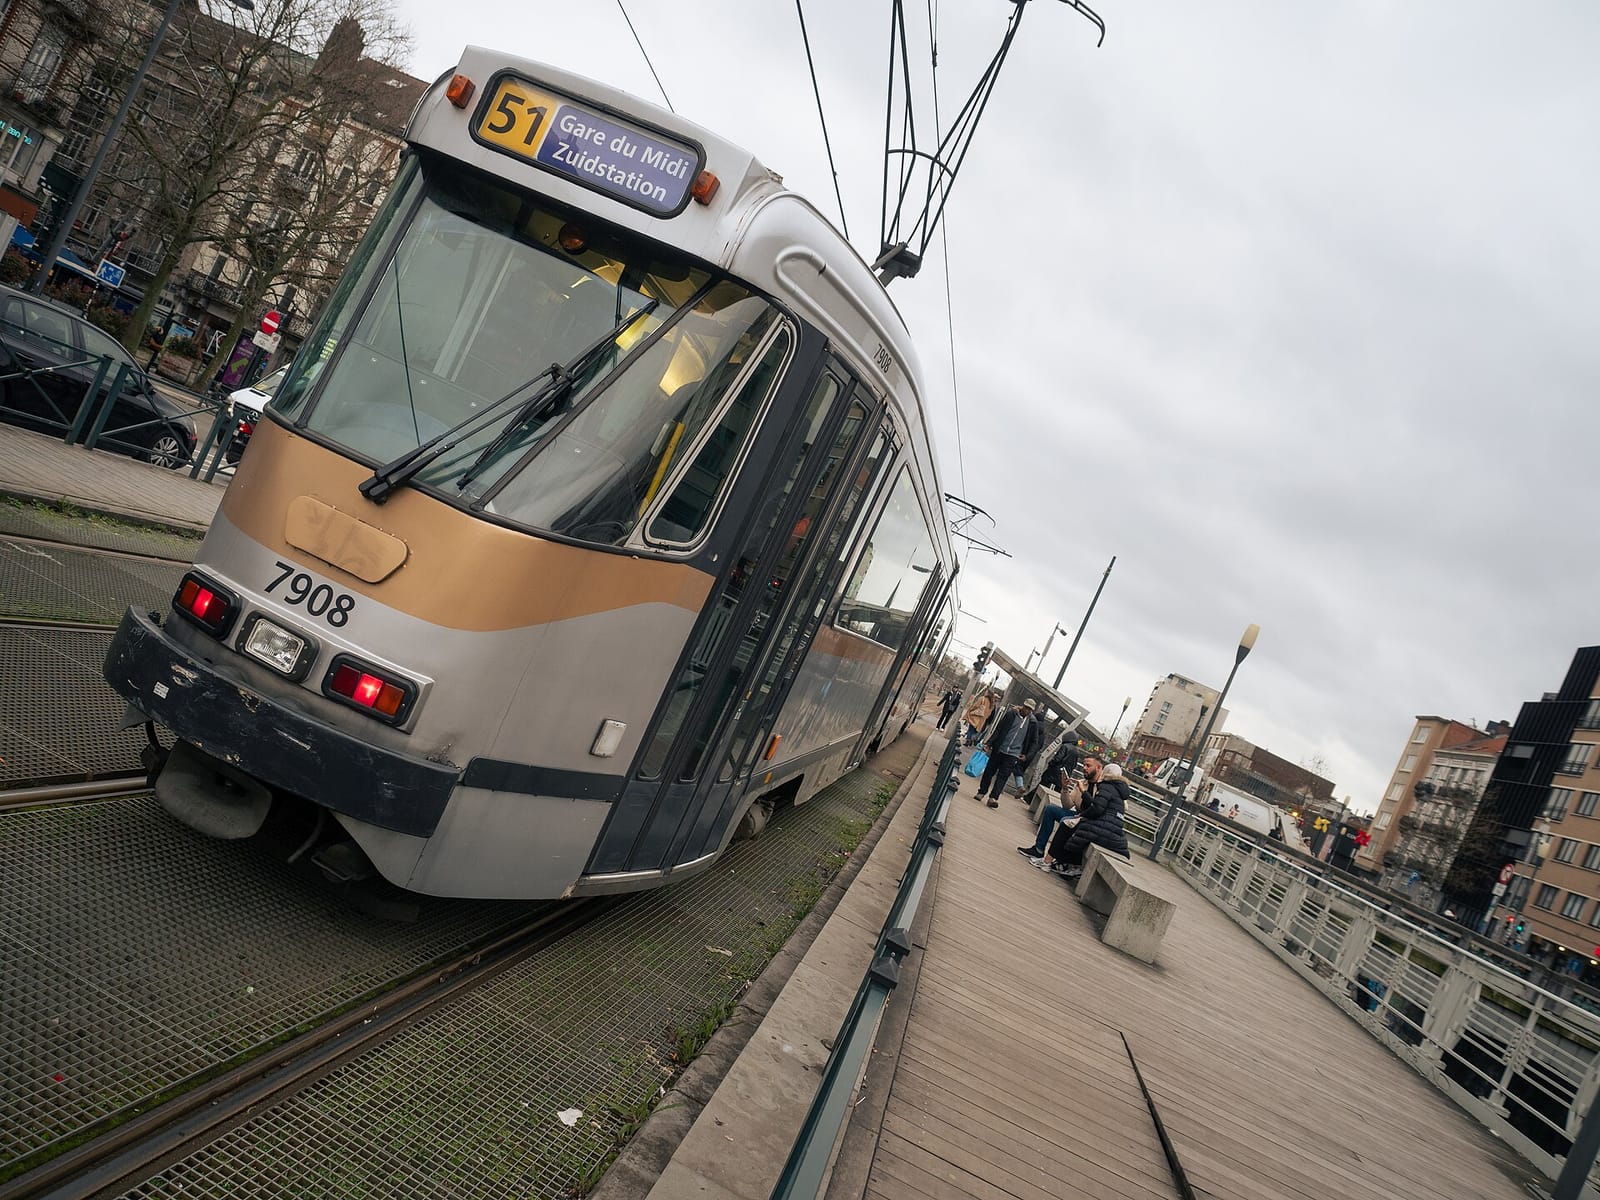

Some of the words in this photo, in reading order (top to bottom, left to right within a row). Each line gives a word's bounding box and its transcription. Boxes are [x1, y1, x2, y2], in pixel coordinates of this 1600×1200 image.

[487, 93, 548, 146] 51
[559, 115, 606, 146] Gare
[609, 135, 638, 159] du
[640, 147, 689, 180] Midi
[552, 142, 667, 202] Zuidstation
[873, 343, 892, 373] 7908
[263, 561, 355, 628] 7908
